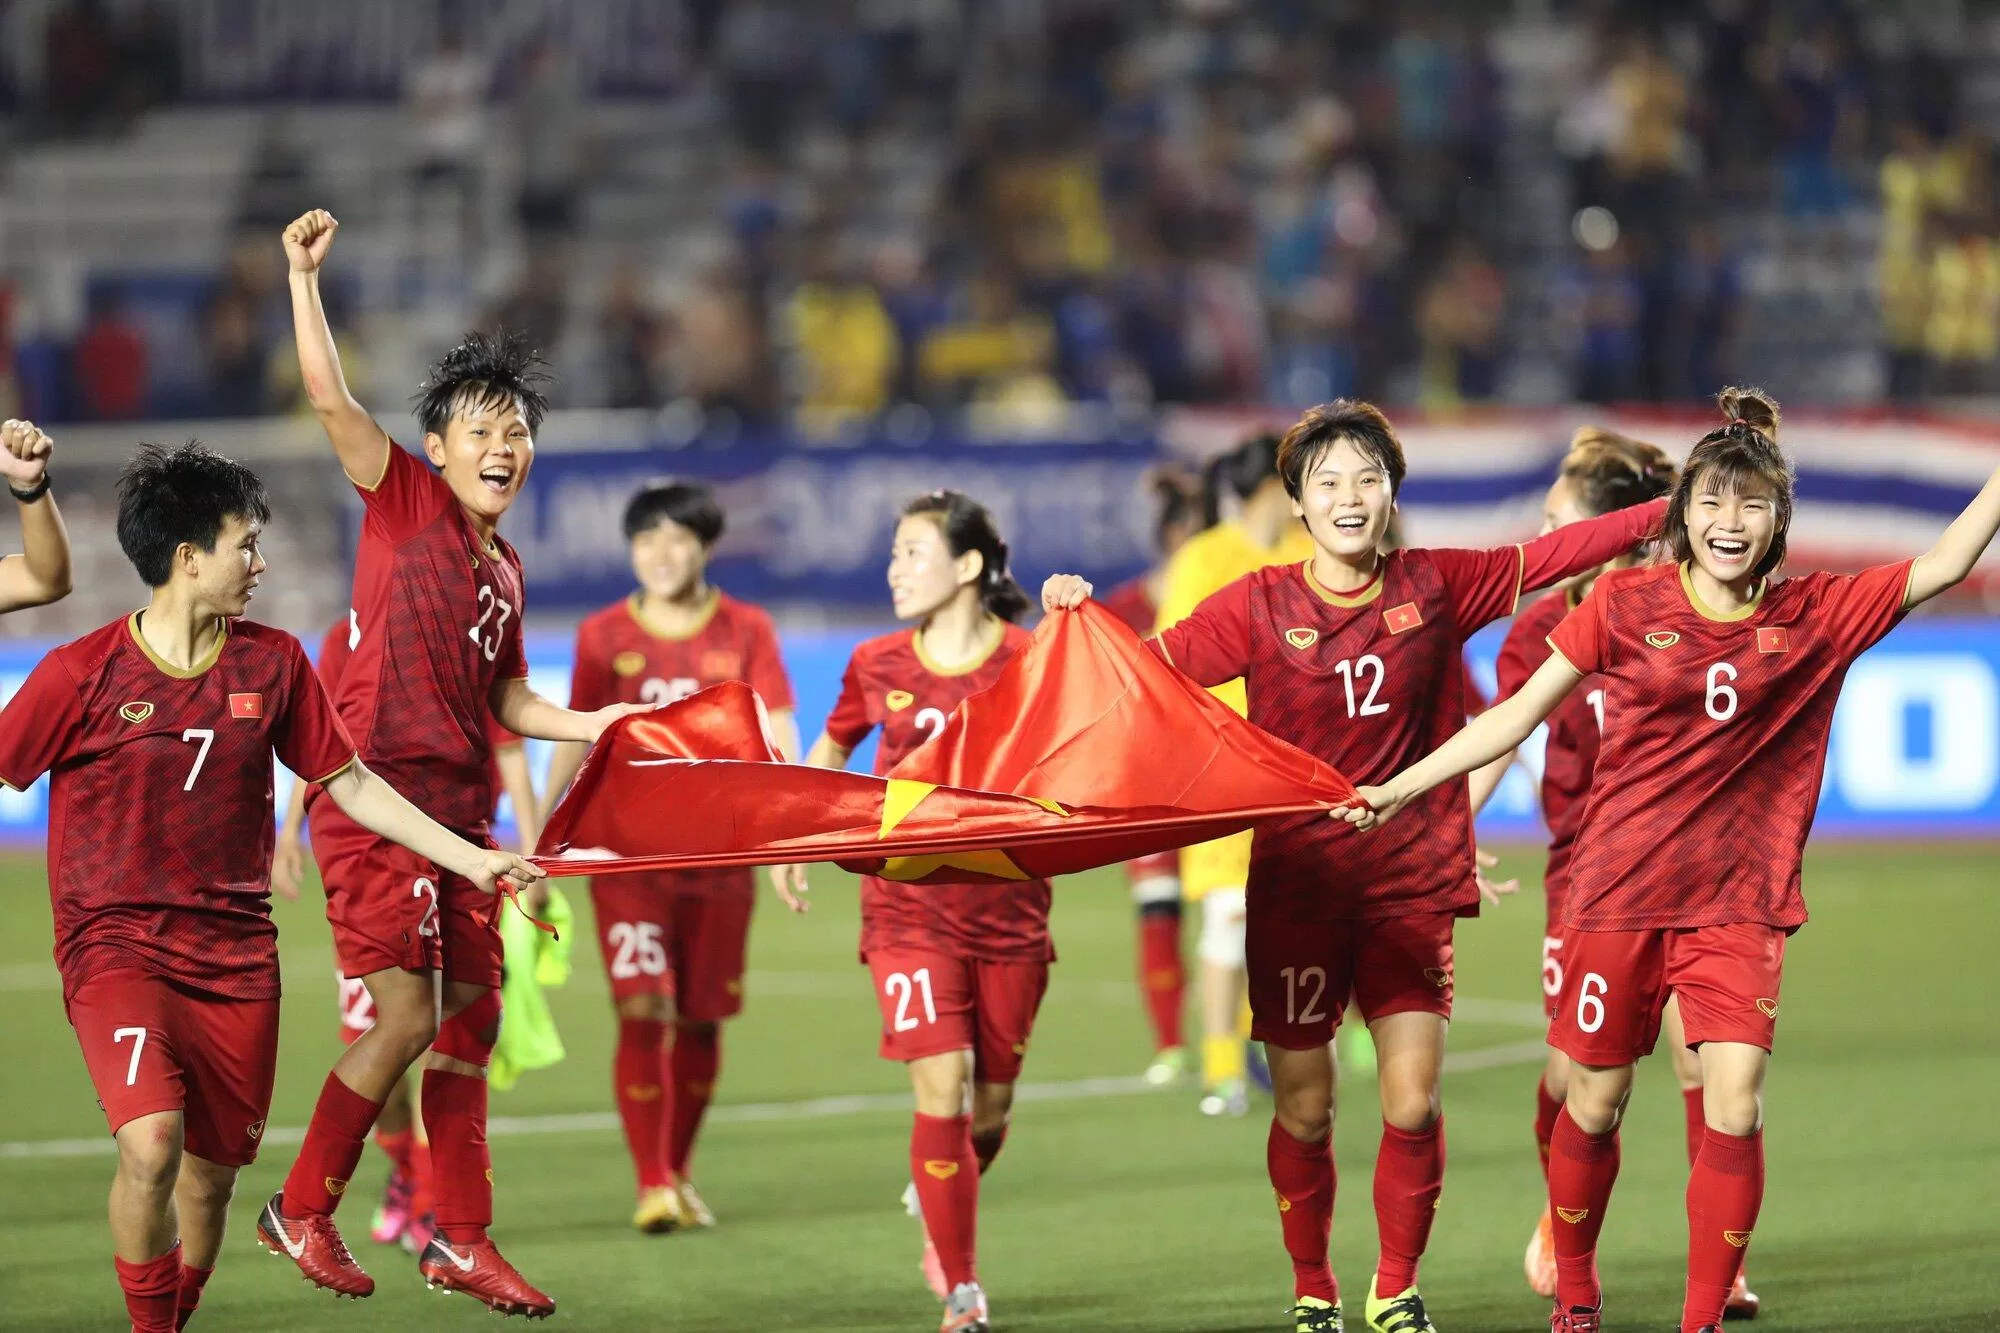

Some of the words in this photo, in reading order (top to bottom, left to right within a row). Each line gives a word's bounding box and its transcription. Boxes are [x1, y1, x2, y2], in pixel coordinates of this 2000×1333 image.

[468, 585, 512, 661] 23
[1334, 654, 1390, 719] 12
[1705, 661, 1738, 721] 6
[914, 707, 954, 741] 2
[182, 728, 215, 791] 7
[413, 877, 441, 937] 2
[607, 921, 667, 979] 25
[885, 967, 937, 1033] 21
[1280, 966, 1327, 1024] 12
[1577, 972, 1608, 1033] 6
[113, 1027, 147, 1086] 7
